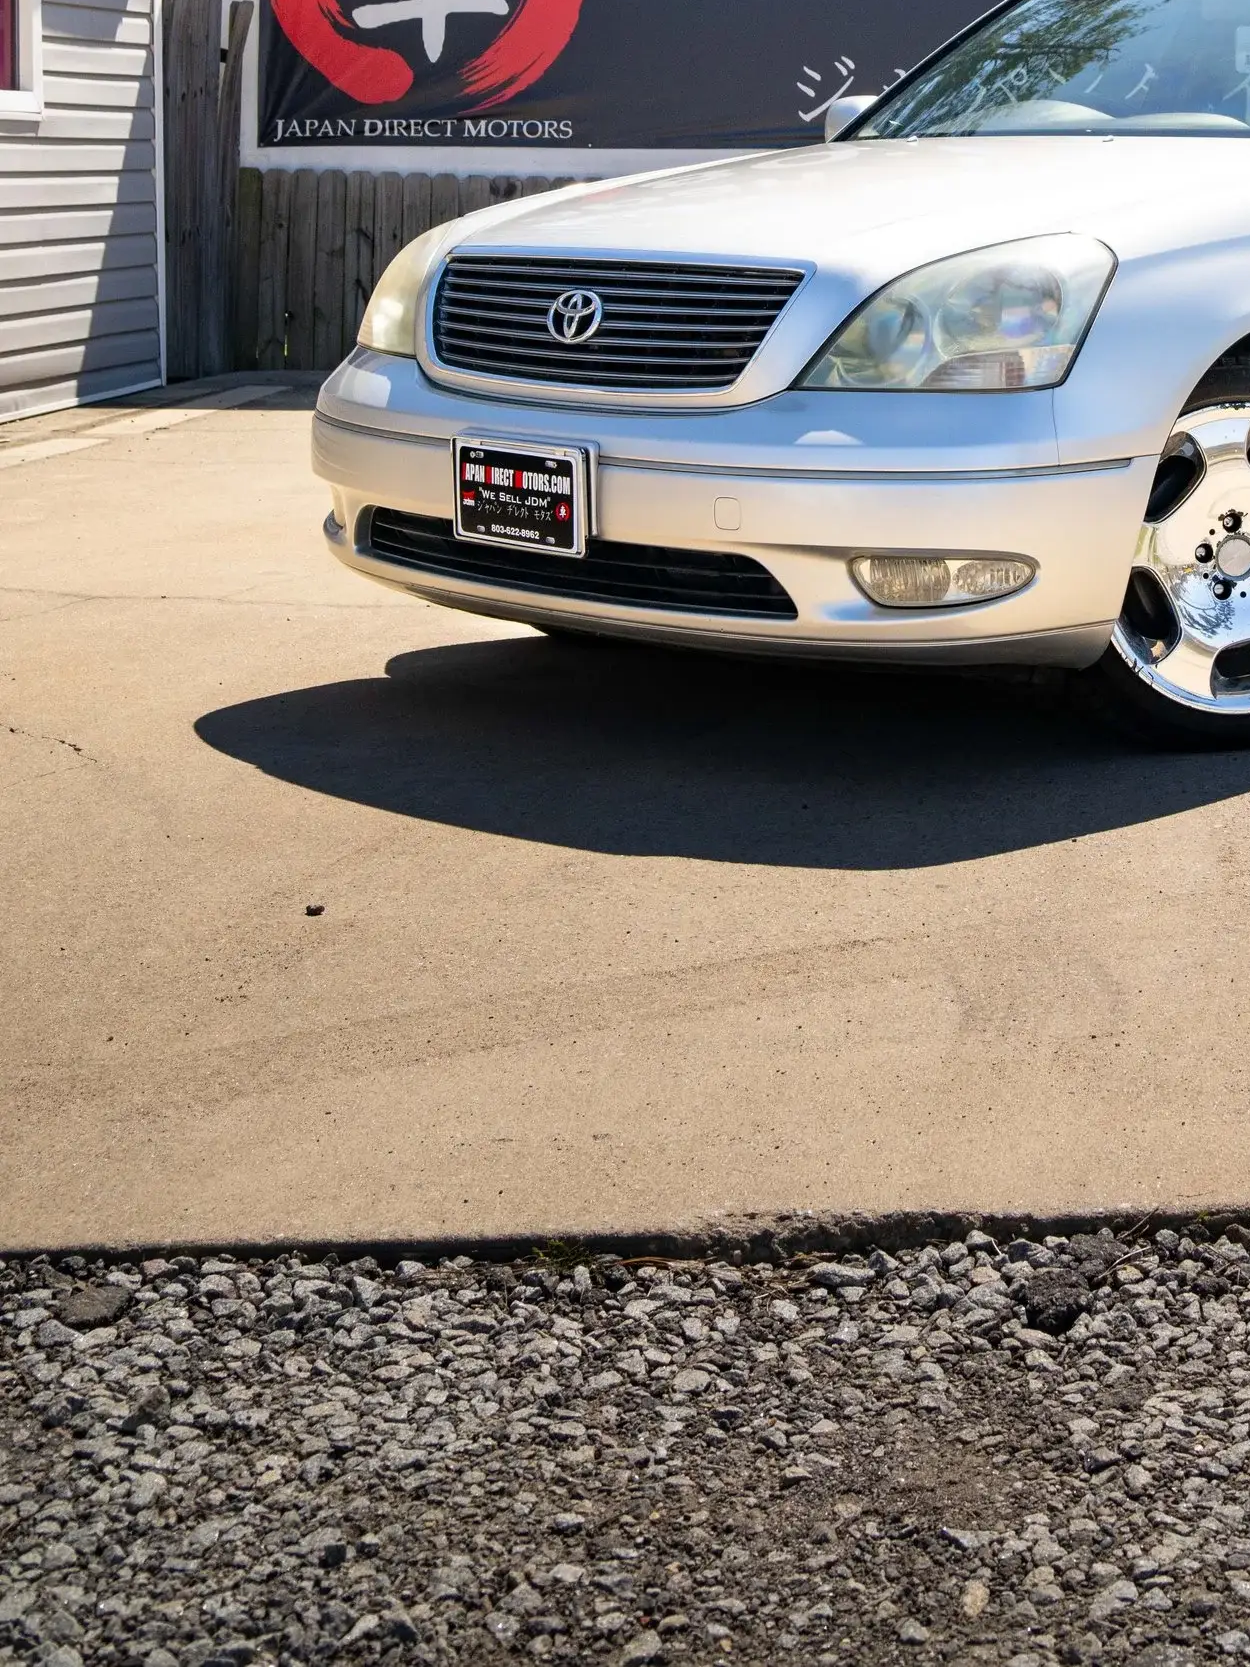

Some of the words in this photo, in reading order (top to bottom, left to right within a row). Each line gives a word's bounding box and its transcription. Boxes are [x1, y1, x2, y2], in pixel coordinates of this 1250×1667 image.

[273, 119, 355, 142] JAPAN
[363, 119, 457, 138] DIRECT
[463, 119, 573, 139] MOTORS
[499, 492, 522, 504] SELL
[491, 524, 540, 540] 803-622-8962
